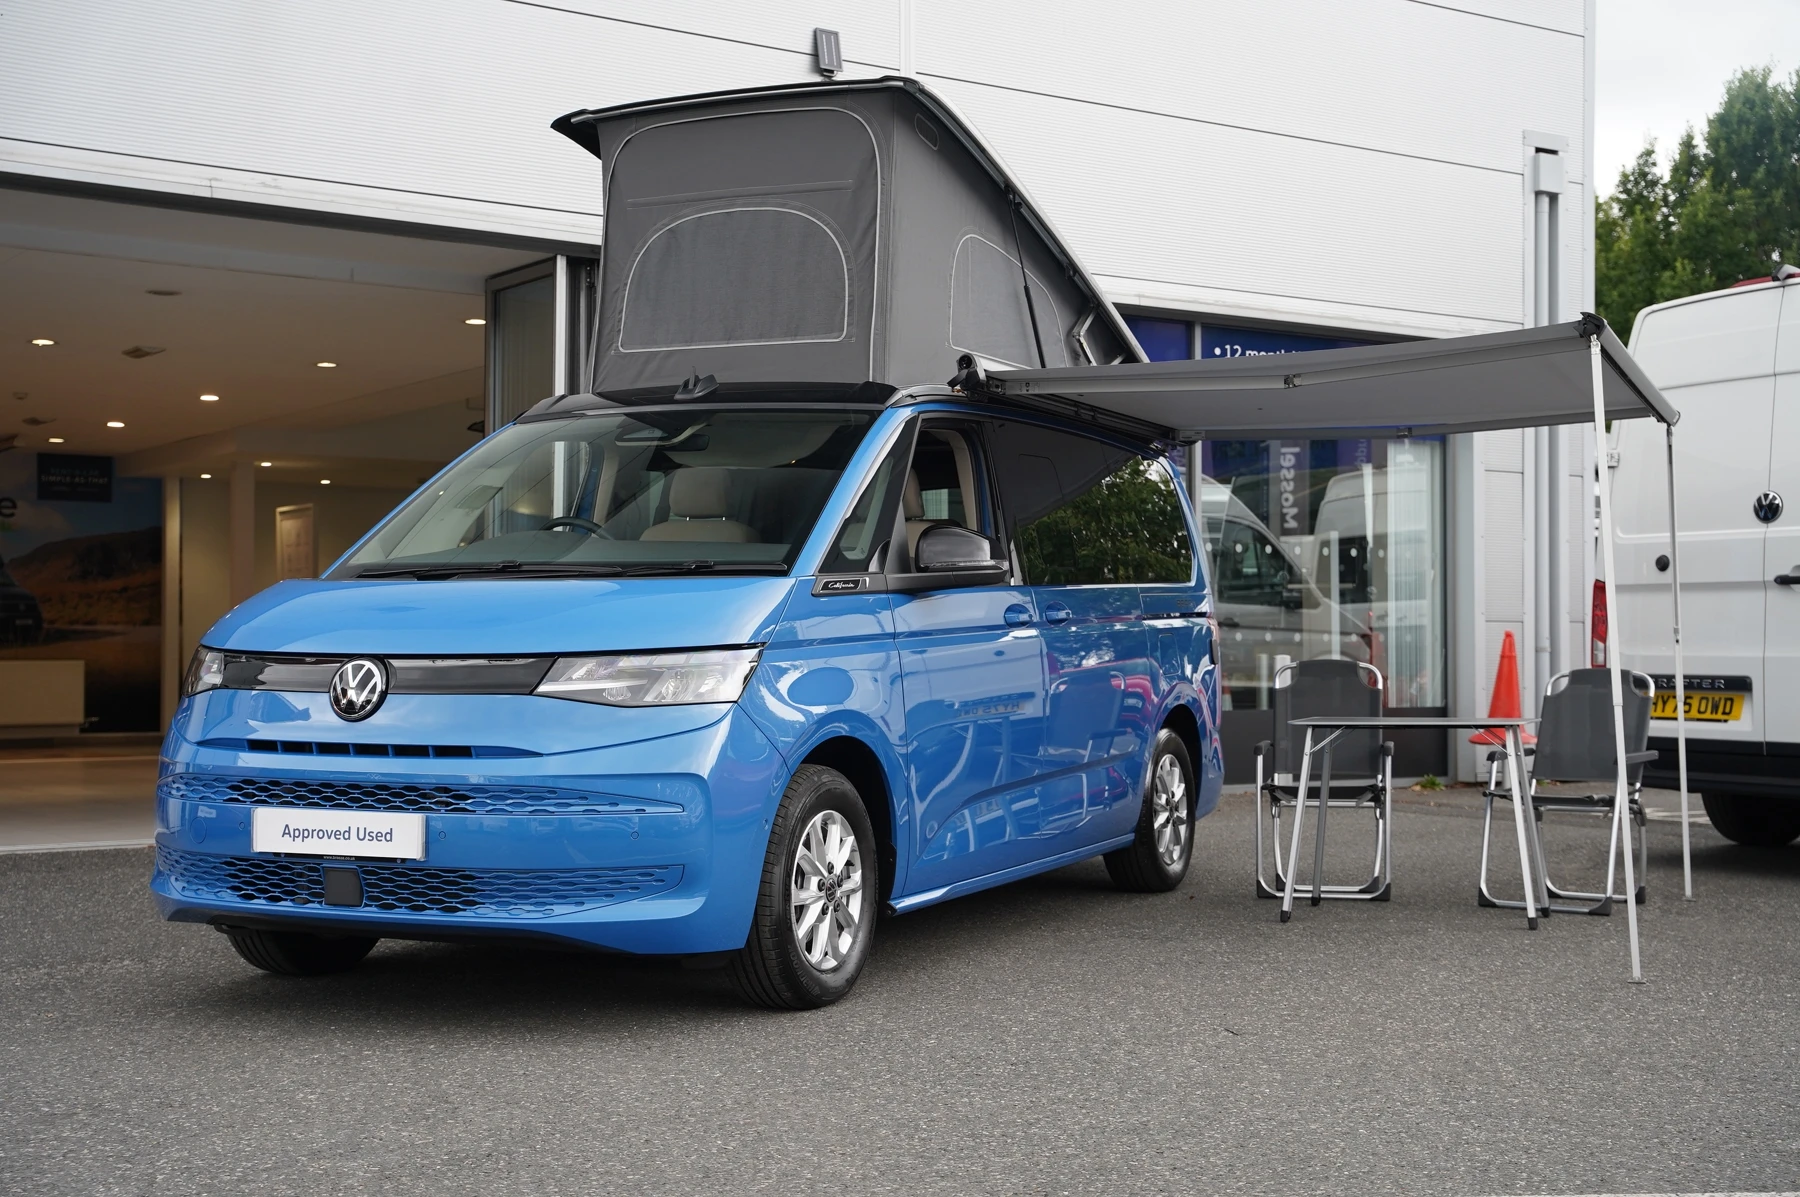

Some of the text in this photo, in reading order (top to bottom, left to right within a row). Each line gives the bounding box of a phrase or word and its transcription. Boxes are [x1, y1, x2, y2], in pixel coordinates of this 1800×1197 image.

[1224, 344, 1242, 358] 12
[1652, 678, 1725, 689] RAFTER
[1697, 696, 1735, 716] OWD
[281, 823, 393, 843] Approved Used
